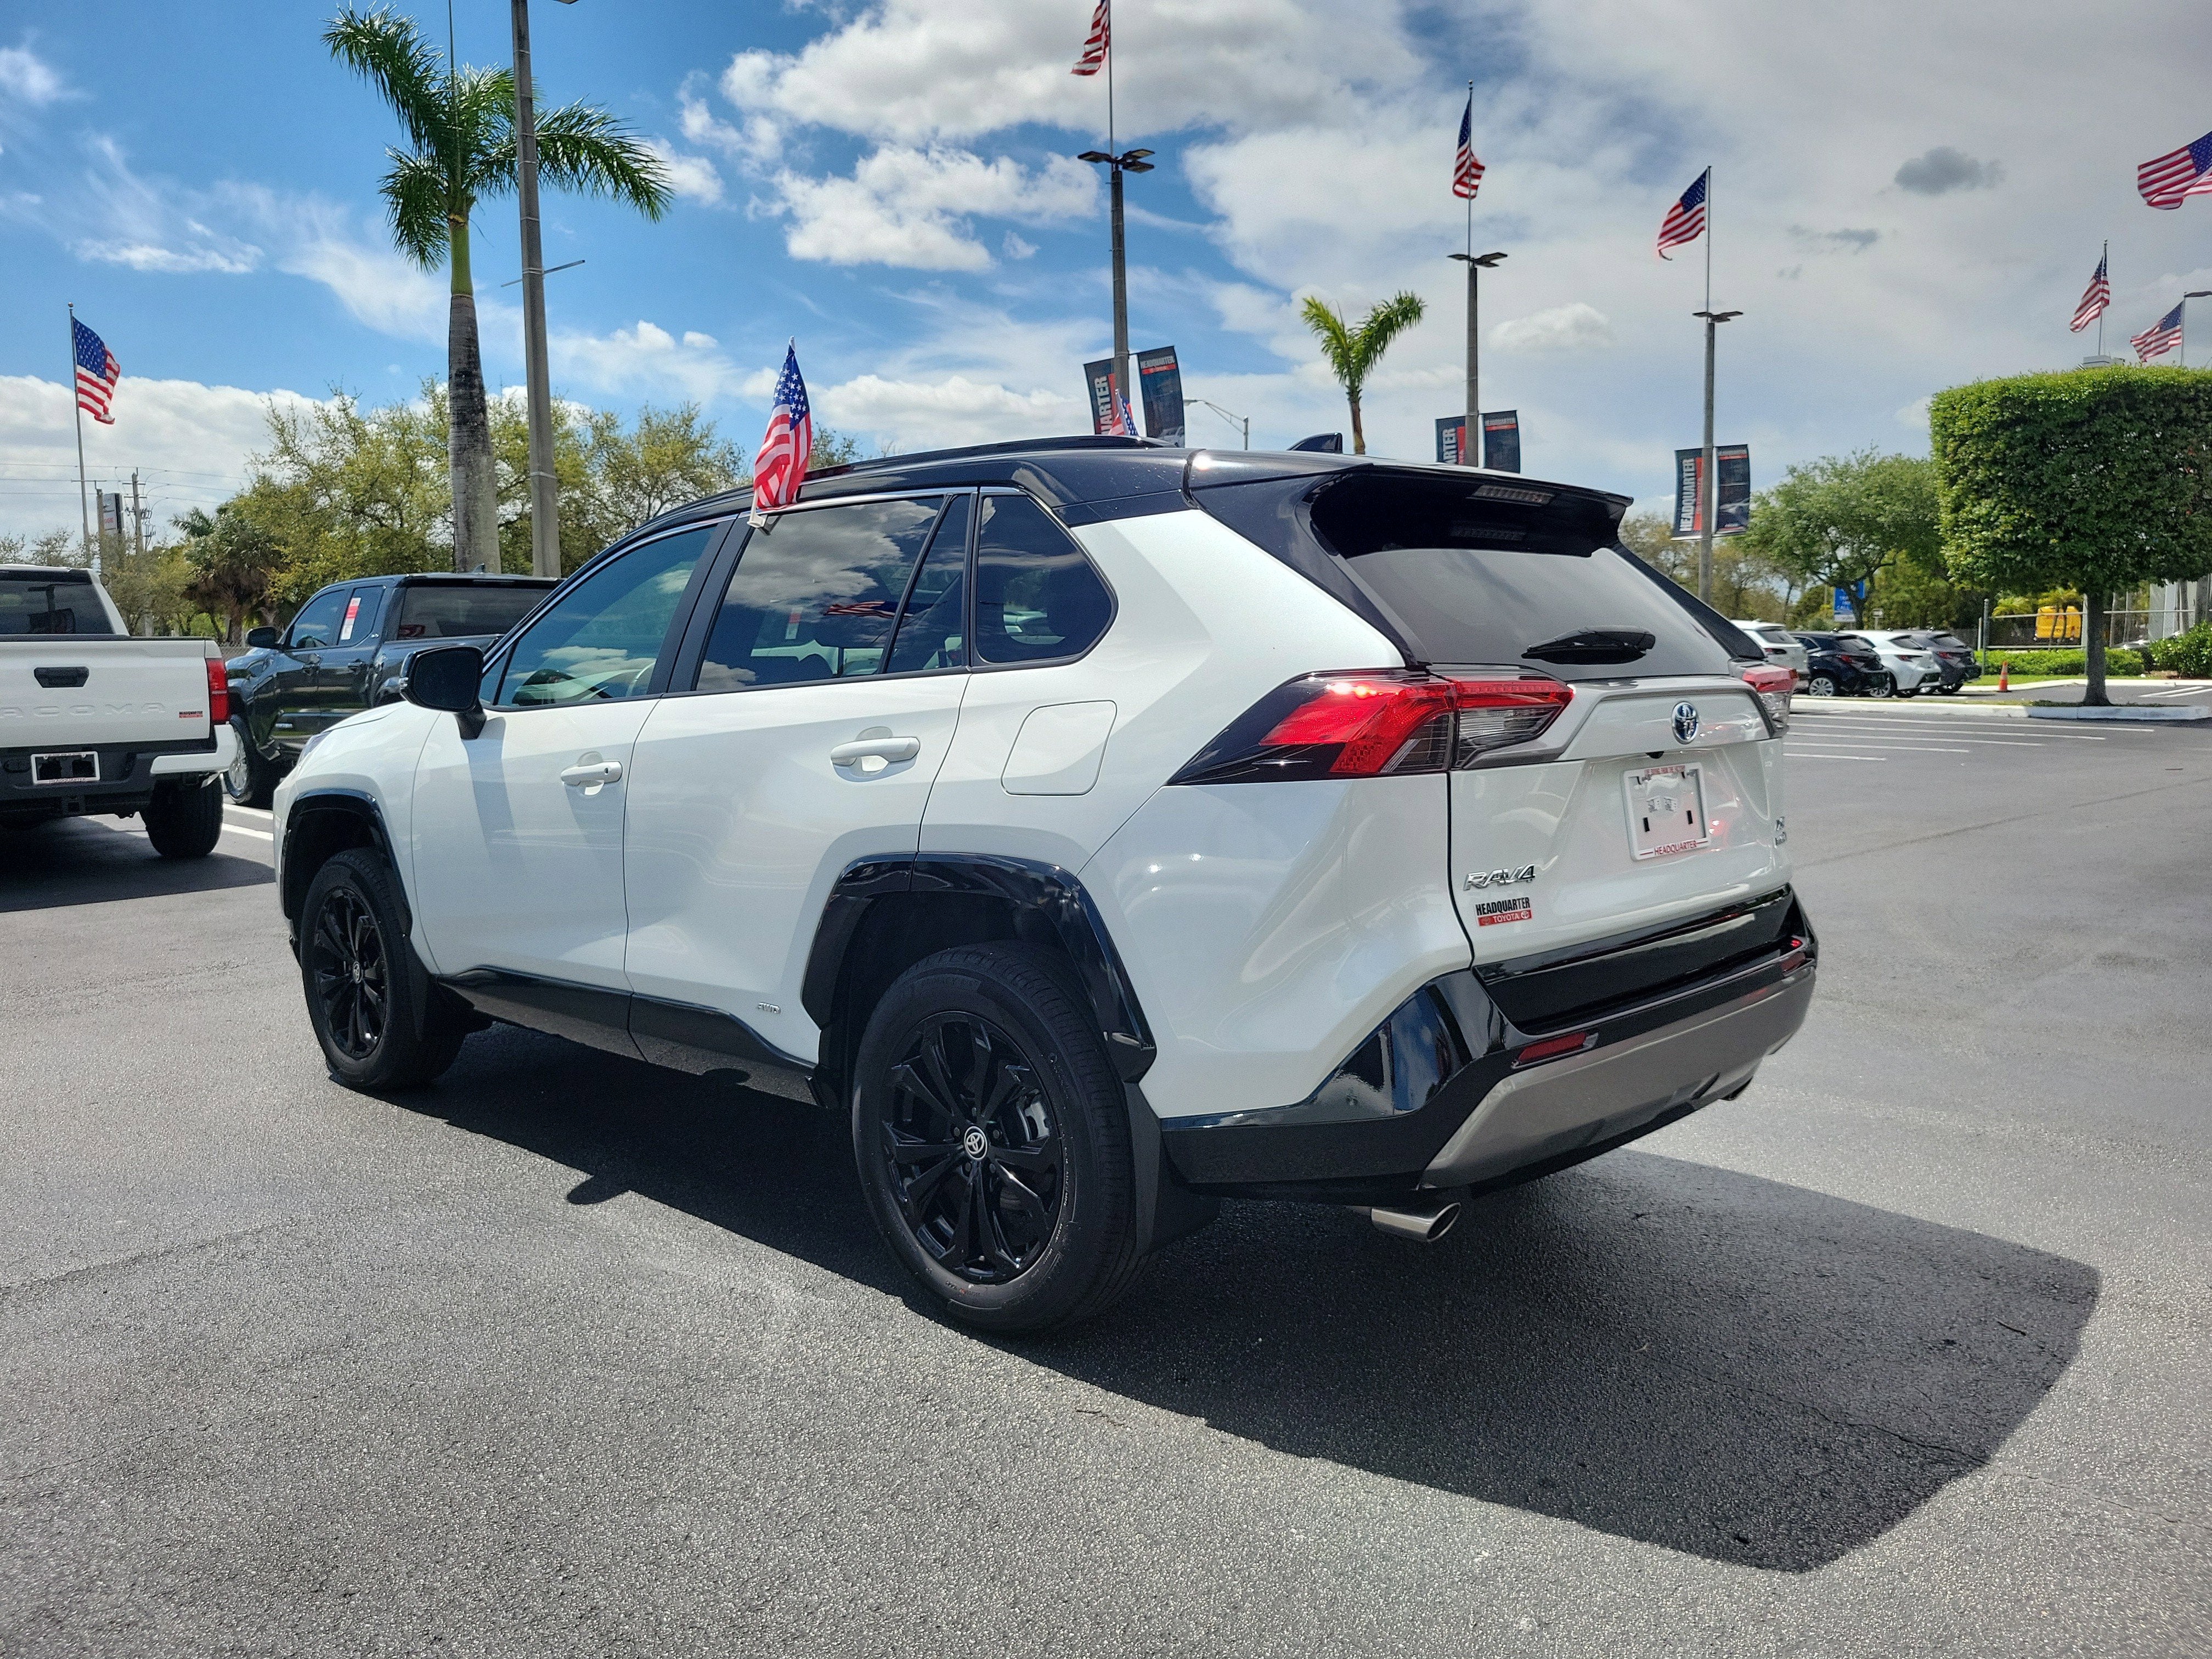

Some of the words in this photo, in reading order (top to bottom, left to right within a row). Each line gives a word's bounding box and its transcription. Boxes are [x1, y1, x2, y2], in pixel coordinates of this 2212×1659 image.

[1679, 458, 1695, 532] HEADQUARTER
[1654, 839, 1697, 855] HEADQUARTER
[1463, 864, 1536, 891] RAV4
[1475, 896, 1531, 916] HEADQUARTER
[1493, 912, 1520, 923] TOYOTA
